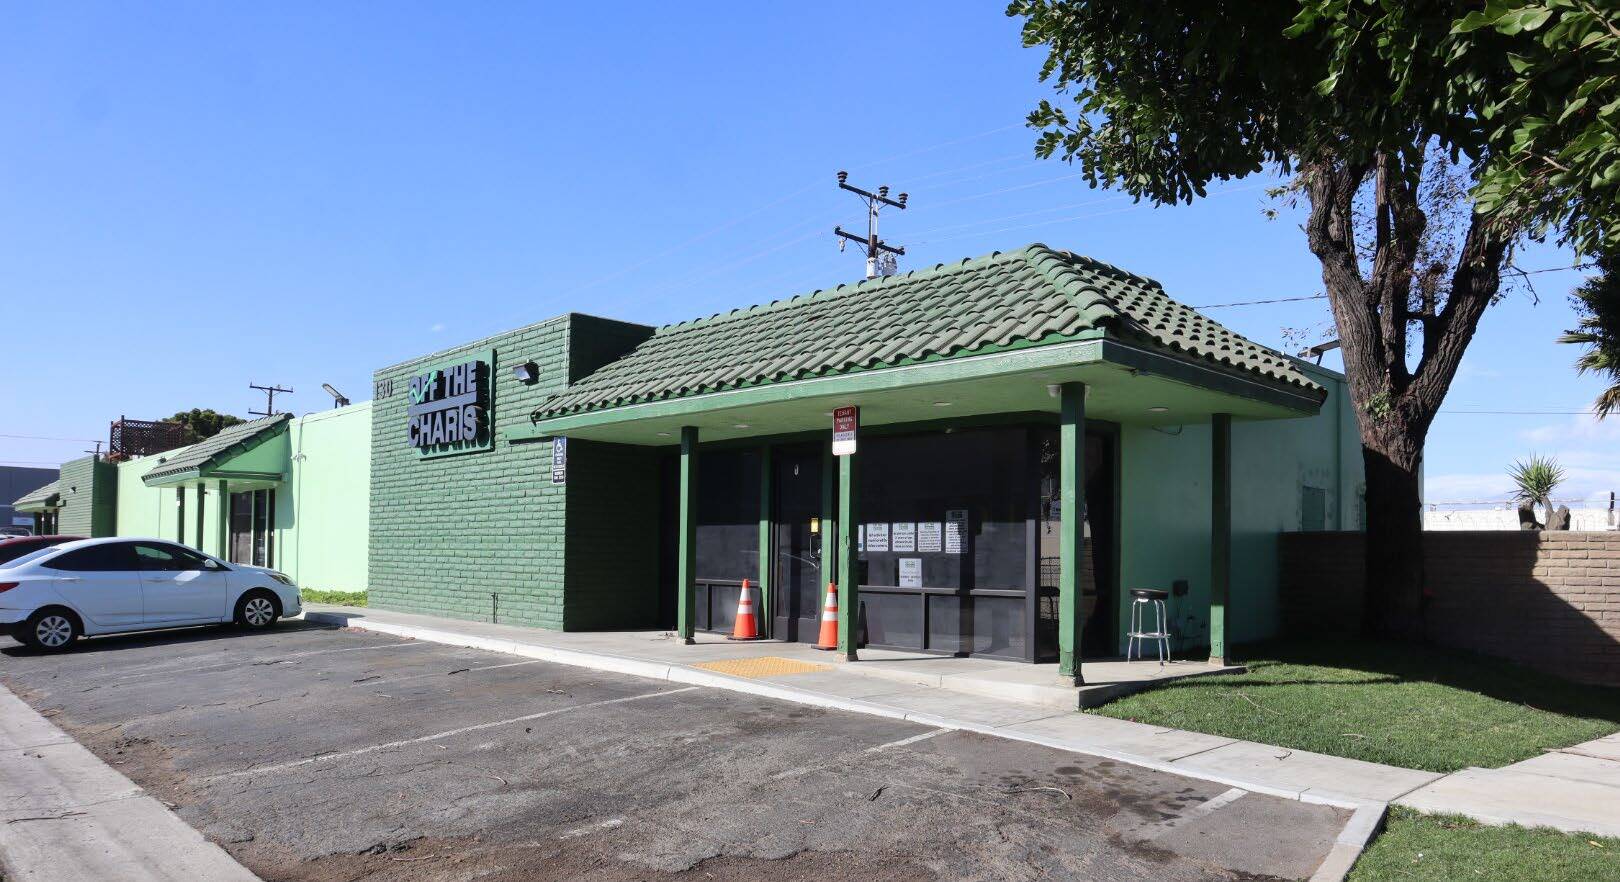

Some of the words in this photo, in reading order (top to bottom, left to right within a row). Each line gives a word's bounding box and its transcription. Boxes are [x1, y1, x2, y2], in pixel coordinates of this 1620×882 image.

[408, 371, 438, 404] OFF
[443, 361, 477, 398] THE
[408, 405, 477, 447] CHARTS
